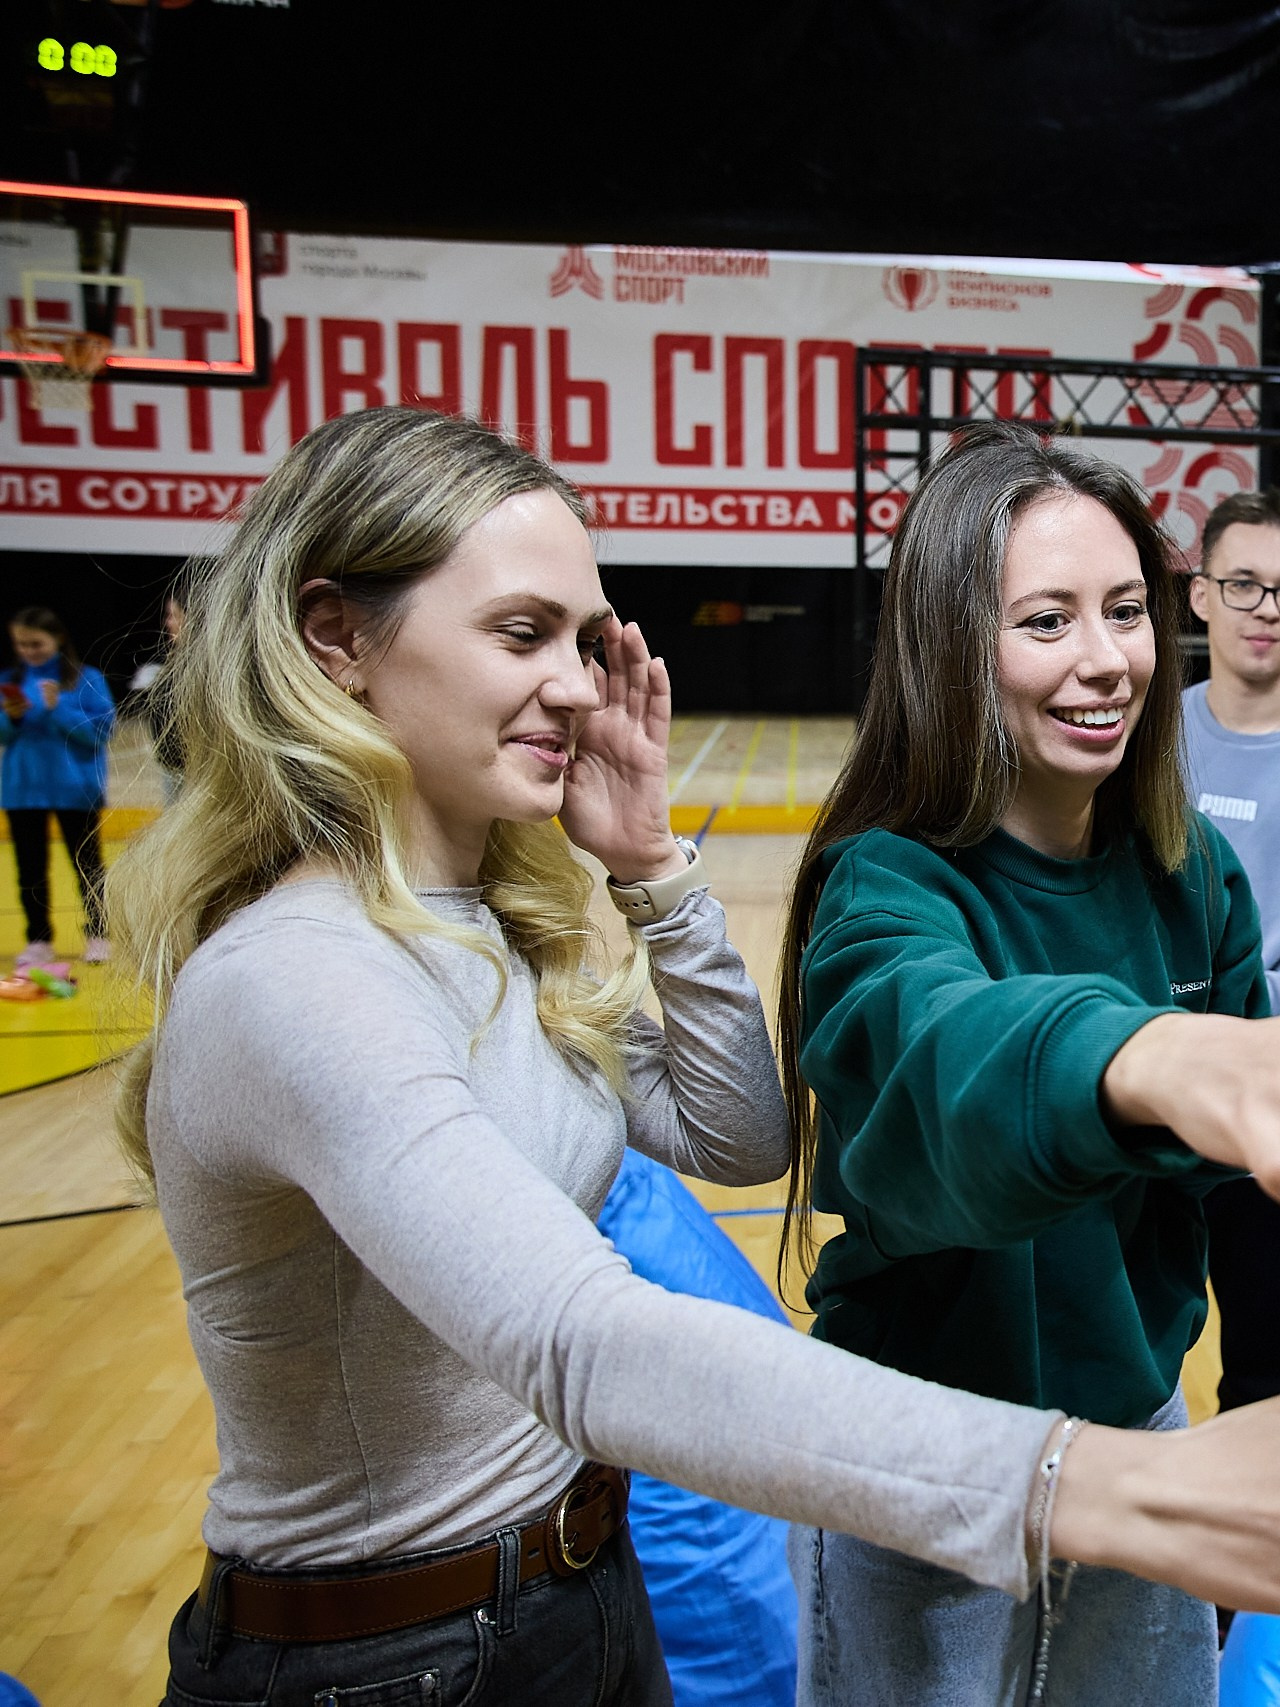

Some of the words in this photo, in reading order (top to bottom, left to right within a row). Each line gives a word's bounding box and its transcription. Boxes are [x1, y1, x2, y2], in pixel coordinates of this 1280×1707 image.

[613, 275, 686, 305] СПОРТ
[0, 299, 610, 464] ЕСТИВАЛЬ
[0, 473, 62, 507] ЛЯ
[79, 476, 260, 513] СОТРУ
[837, 497, 900, 529] МО
[1198, 792, 1259, 822] PUMA
